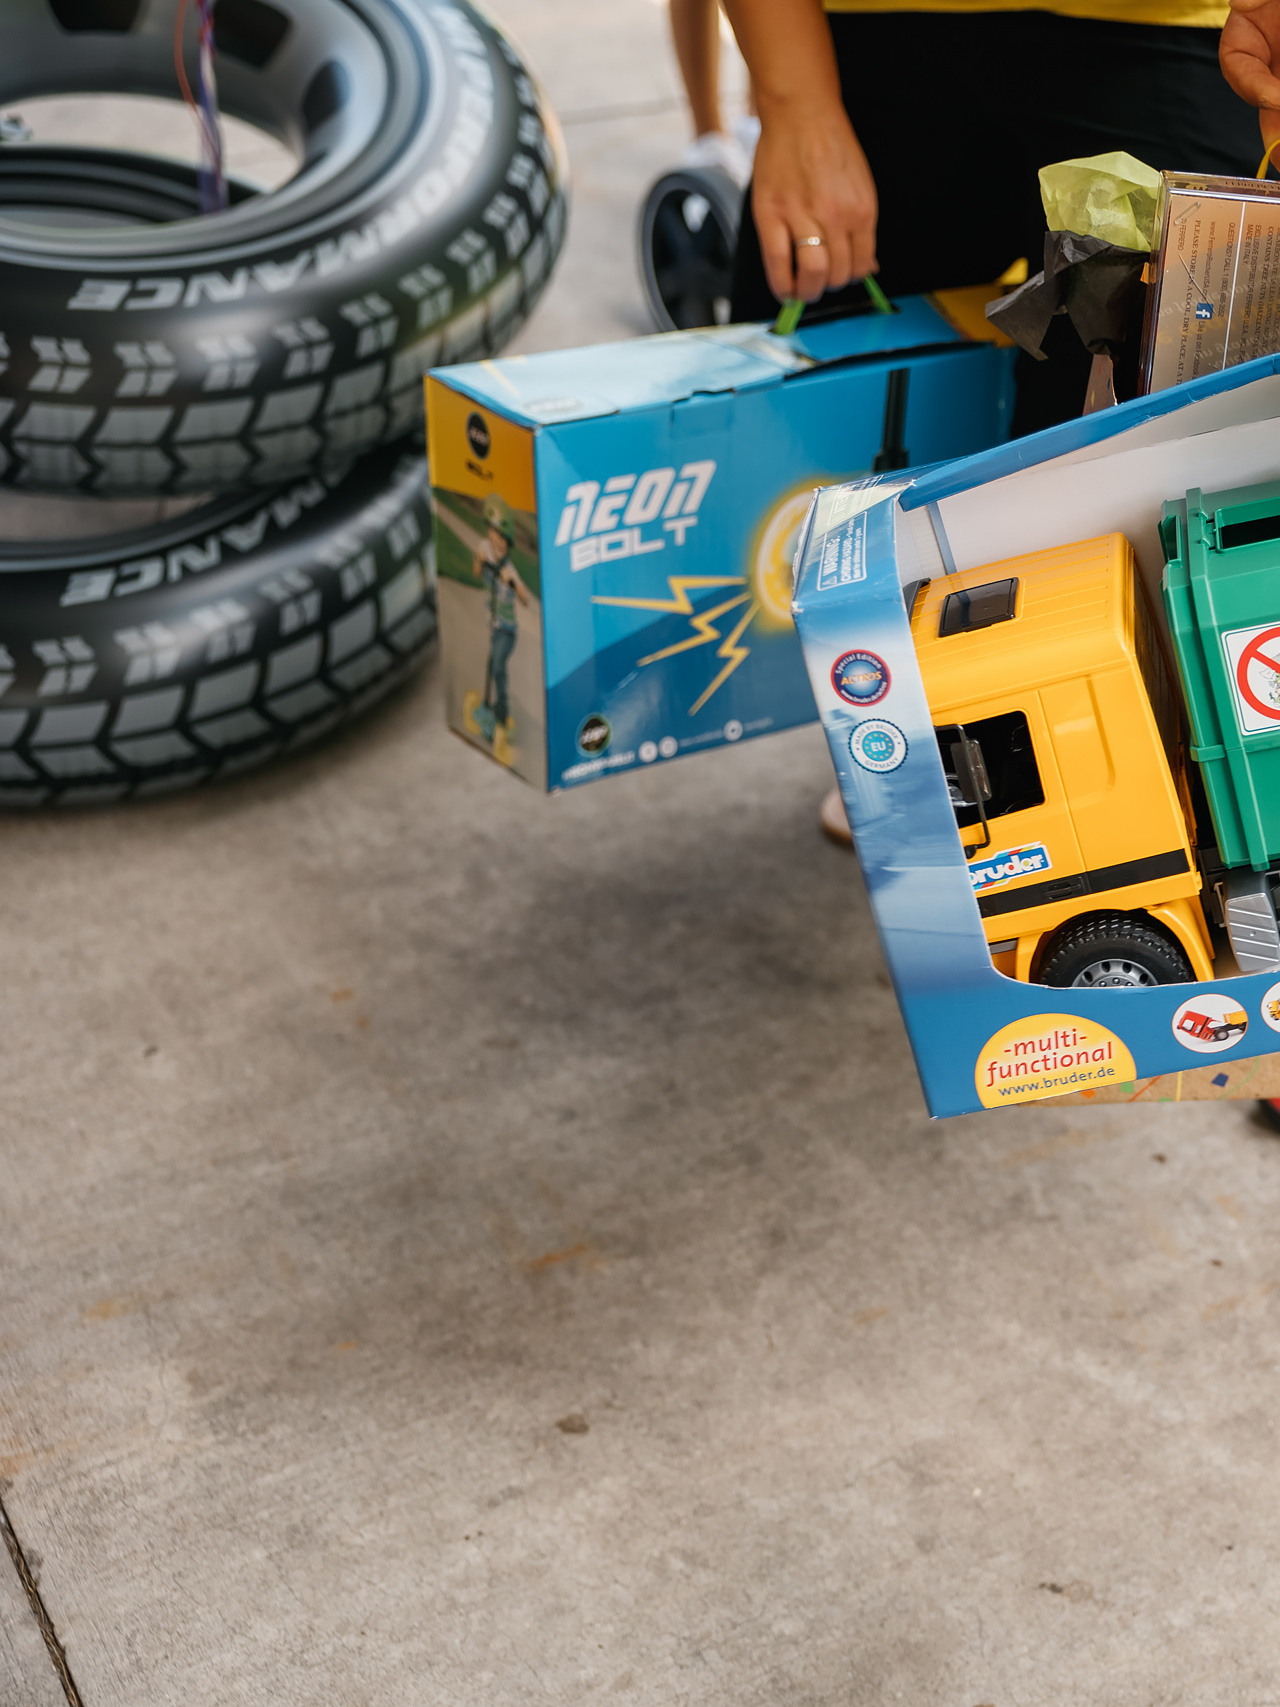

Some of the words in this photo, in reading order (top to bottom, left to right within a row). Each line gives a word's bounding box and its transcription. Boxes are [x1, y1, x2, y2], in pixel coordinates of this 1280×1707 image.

[1178, 225, 1187, 251] FERRERO
[1193, 220, 1201, 248] PLEASE
[1226, 222, 1236, 257] QUESTIONS?
[1253, 225, 1261, 255] EXCLUSIVE
[1265, 226, 1274, 262] CONTAINS
[1190, 250, 1198, 274] STORE
[554, 459, 717, 547] NEON
[569, 516, 699, 573] BOLT
[835, 653, 856, 674] Special
[857, 653, 882, 669] Edition
[840, 671, 882, 686] ACTROS
[855, 728, 865, 745] MADE
[875, 723, 898, 739] BRUDER
[870, 741, 886, 752] EU
[865, 757, 899, 769] GERMANY
[1004, 1028, 1087, 1056] -multi-
[986, 1041, 1113, 1087] functional
[998, 1067, 1115, 1096] www.bruder.de
